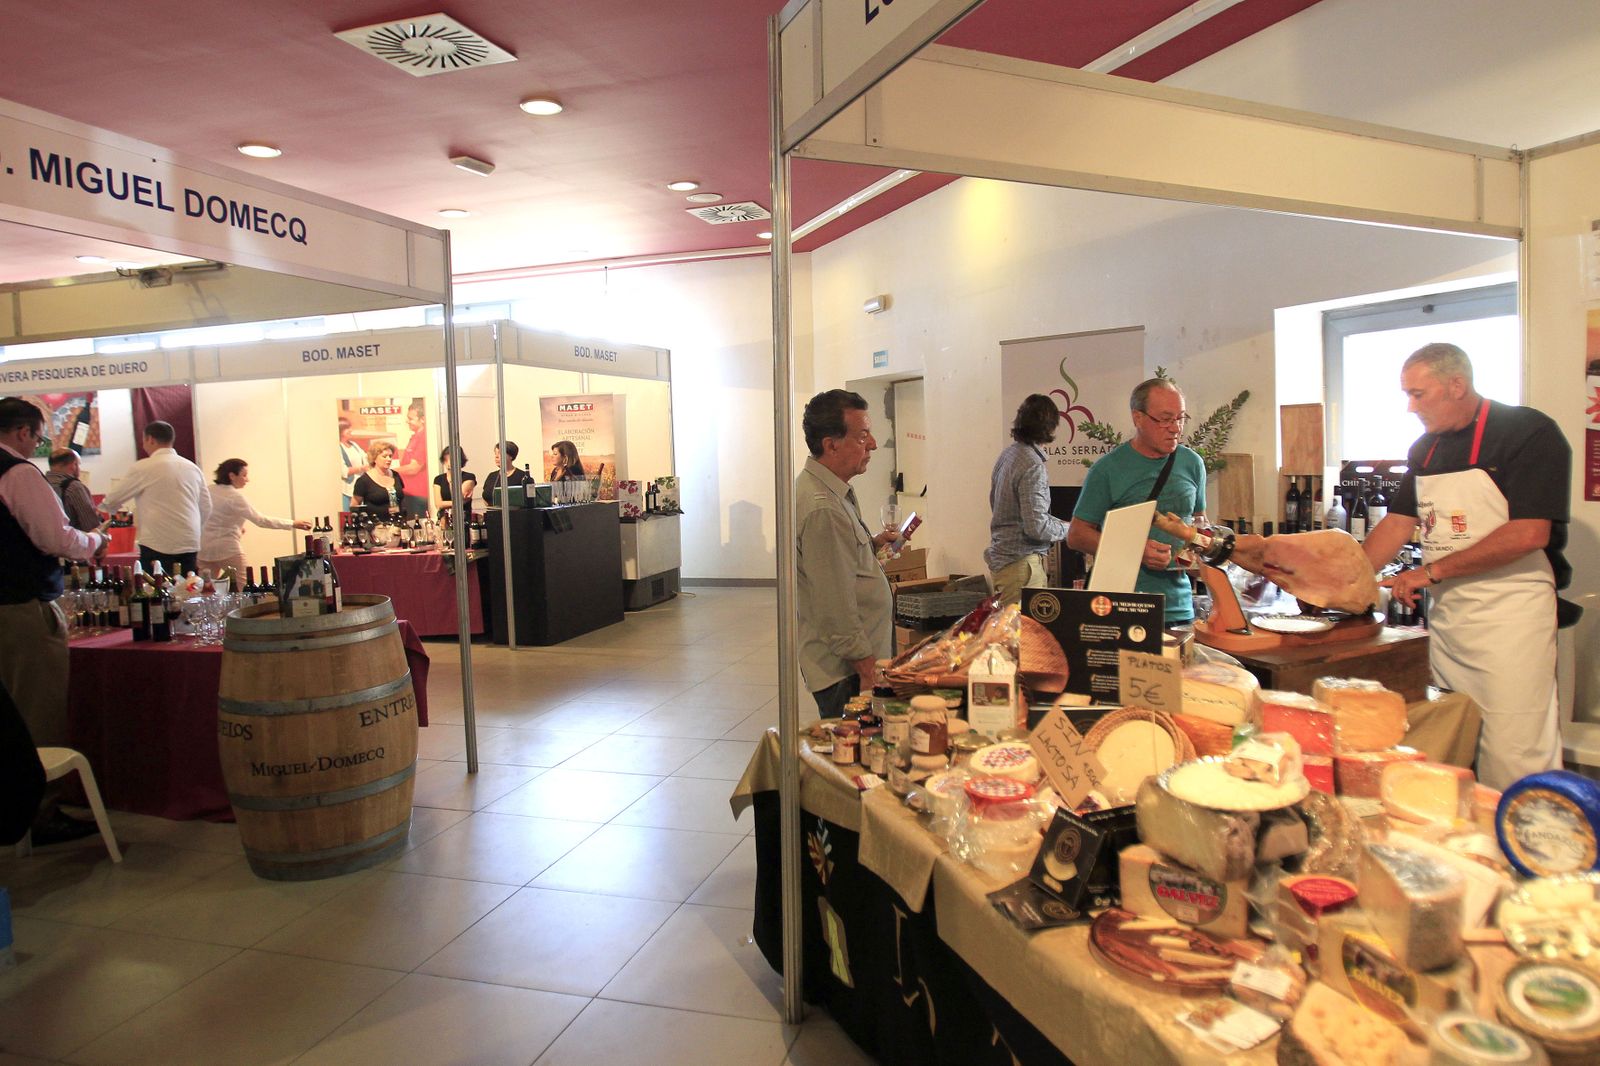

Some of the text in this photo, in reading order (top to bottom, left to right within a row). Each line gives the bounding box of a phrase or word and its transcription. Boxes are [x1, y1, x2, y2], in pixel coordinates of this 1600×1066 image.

[29, 147, 175, 213] MIGUEL
[184, 188, 308, 246] DOMECQ
[302, 344, 381, 362] BOD. MASET
[574, 345, 618, 362] BOD. MASET
[31, 365, 91, 381] PESQUERA
[91, 364, 107, 377] DE
[109, 361, 149, 376] DUERO
[361, 406, 400, 415] MASET
[559, 403, 592, 411] MASET
[1127, 656, 1173, 673] PLATOS
[1128, 677, 1166, 706] 5€
[1054, 716, 1090, 756] SIN
[1036, 729, 1080, 791] LACTOSA
